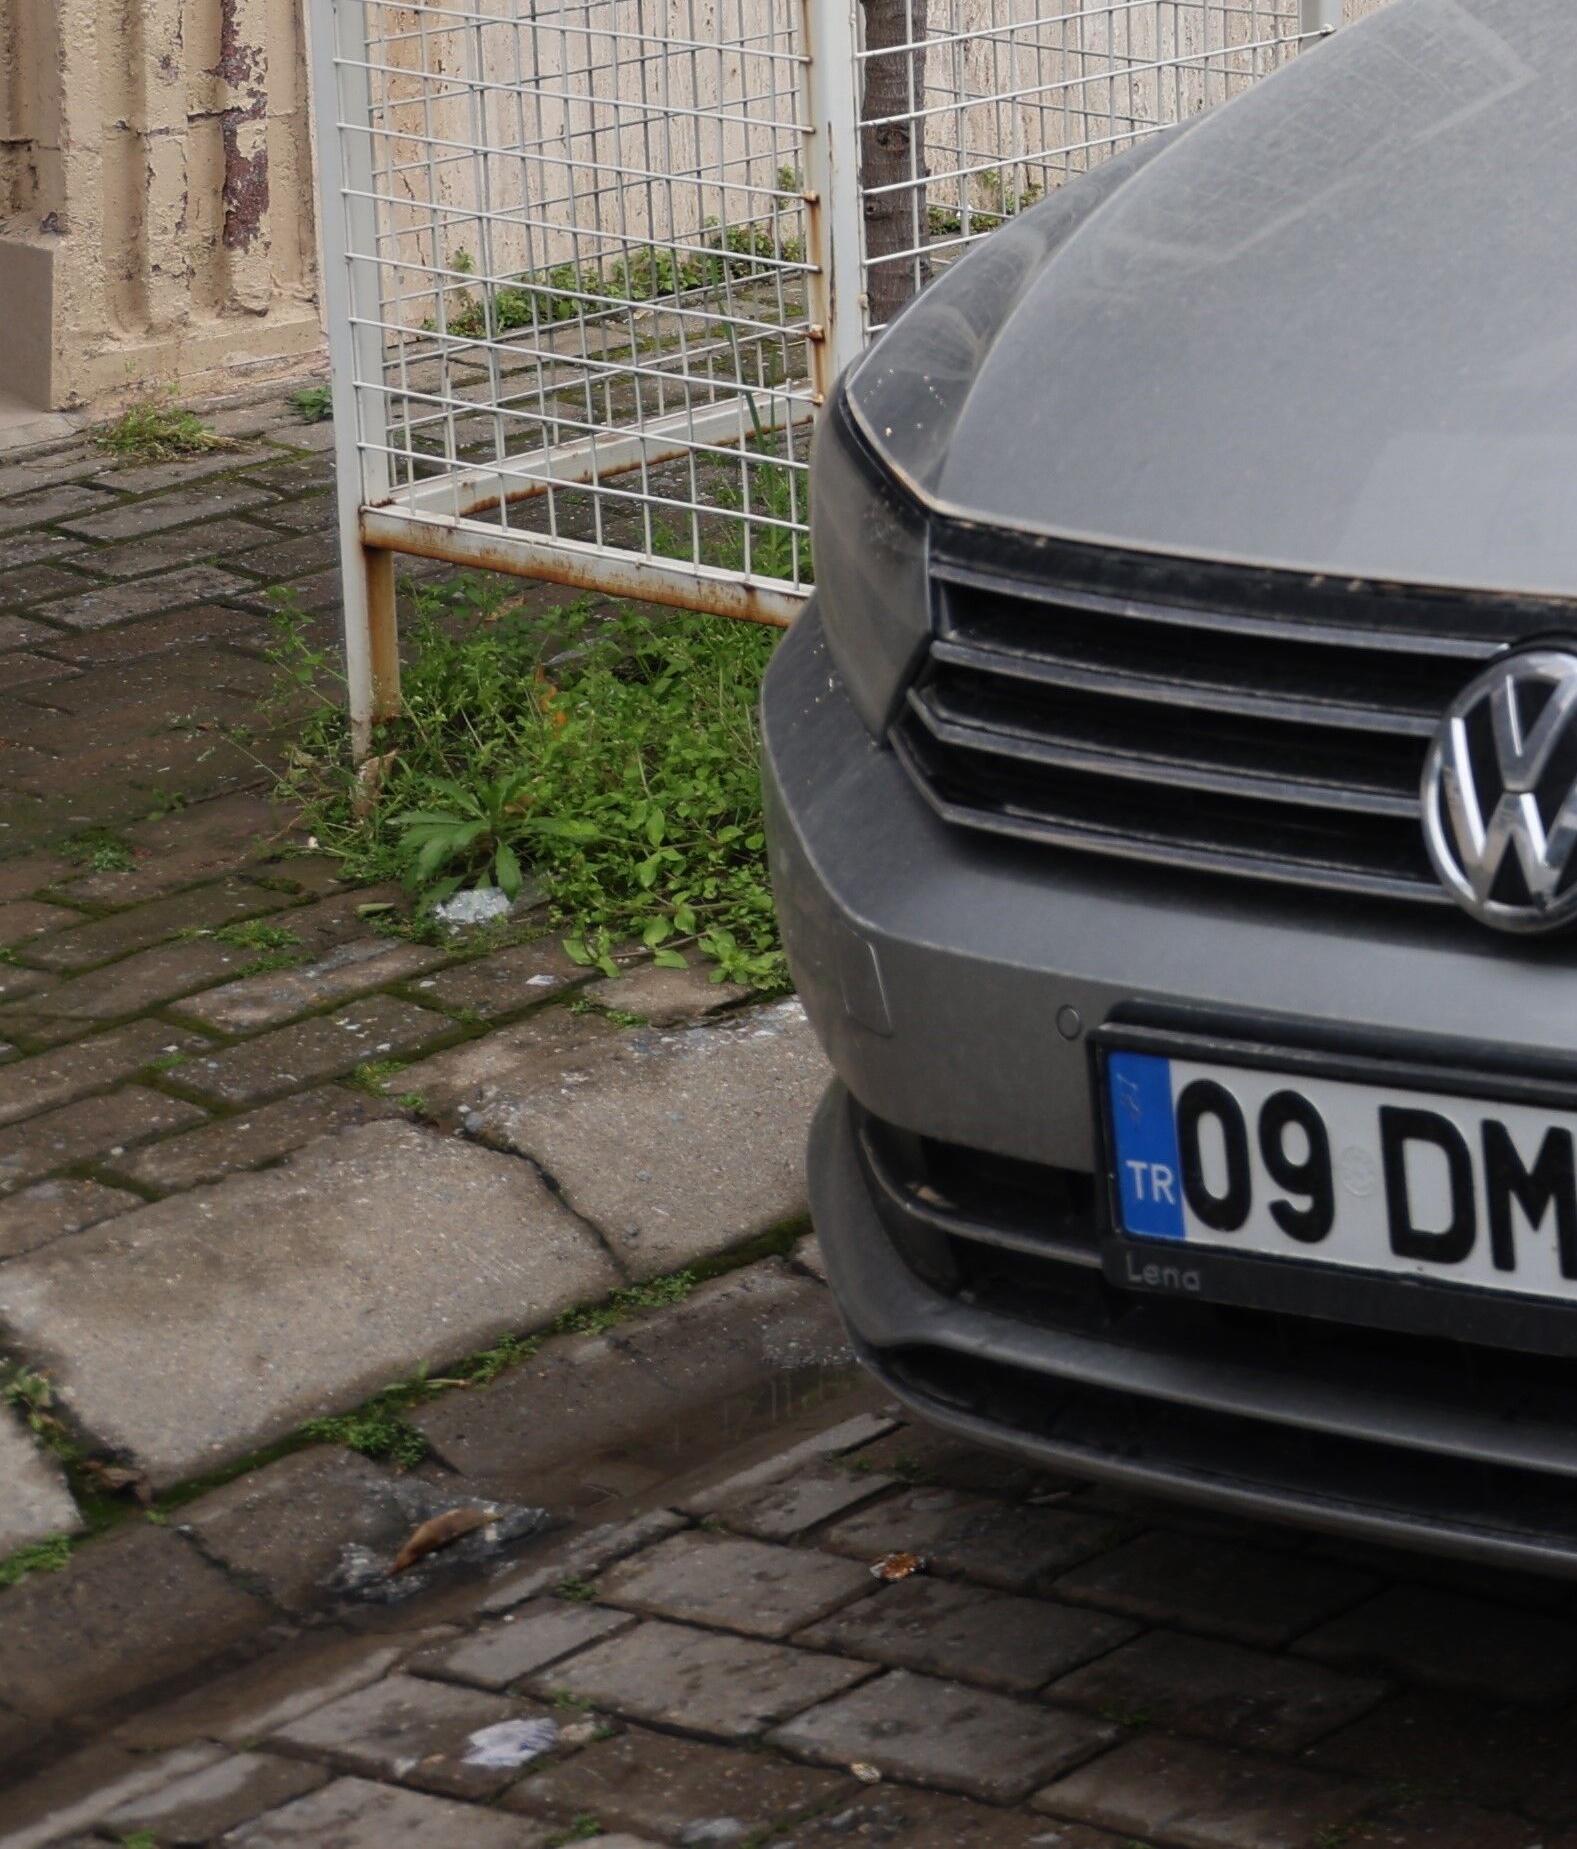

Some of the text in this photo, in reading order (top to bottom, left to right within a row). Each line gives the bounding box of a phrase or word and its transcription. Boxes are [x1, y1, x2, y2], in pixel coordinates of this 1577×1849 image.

[1125, 1159, 1176, 1206] TR
[1175, 1077, 1336, 1245] 09
[1126, 1251, 1200, 1291] Lena
